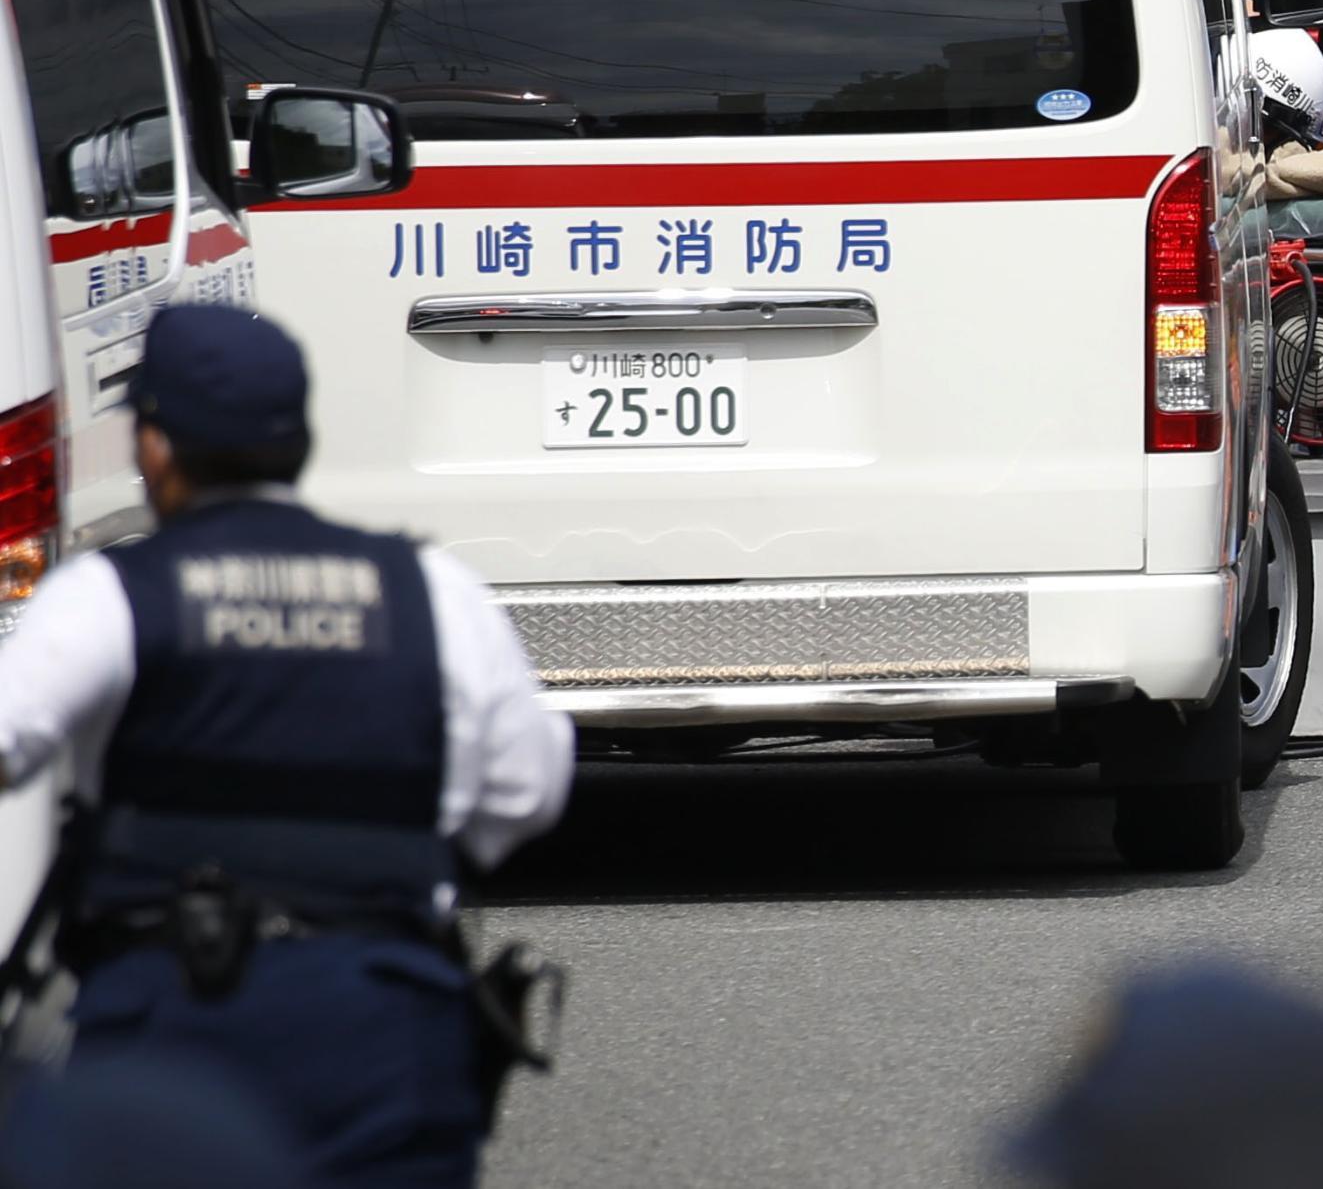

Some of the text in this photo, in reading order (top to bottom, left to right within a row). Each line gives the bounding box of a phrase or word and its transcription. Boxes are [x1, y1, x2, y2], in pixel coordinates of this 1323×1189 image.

[389, 217, 891, 278] 川崎市消防局
[555, 385, 736, 439] す 25-00
[205, 607, 366, 652] POLICE
